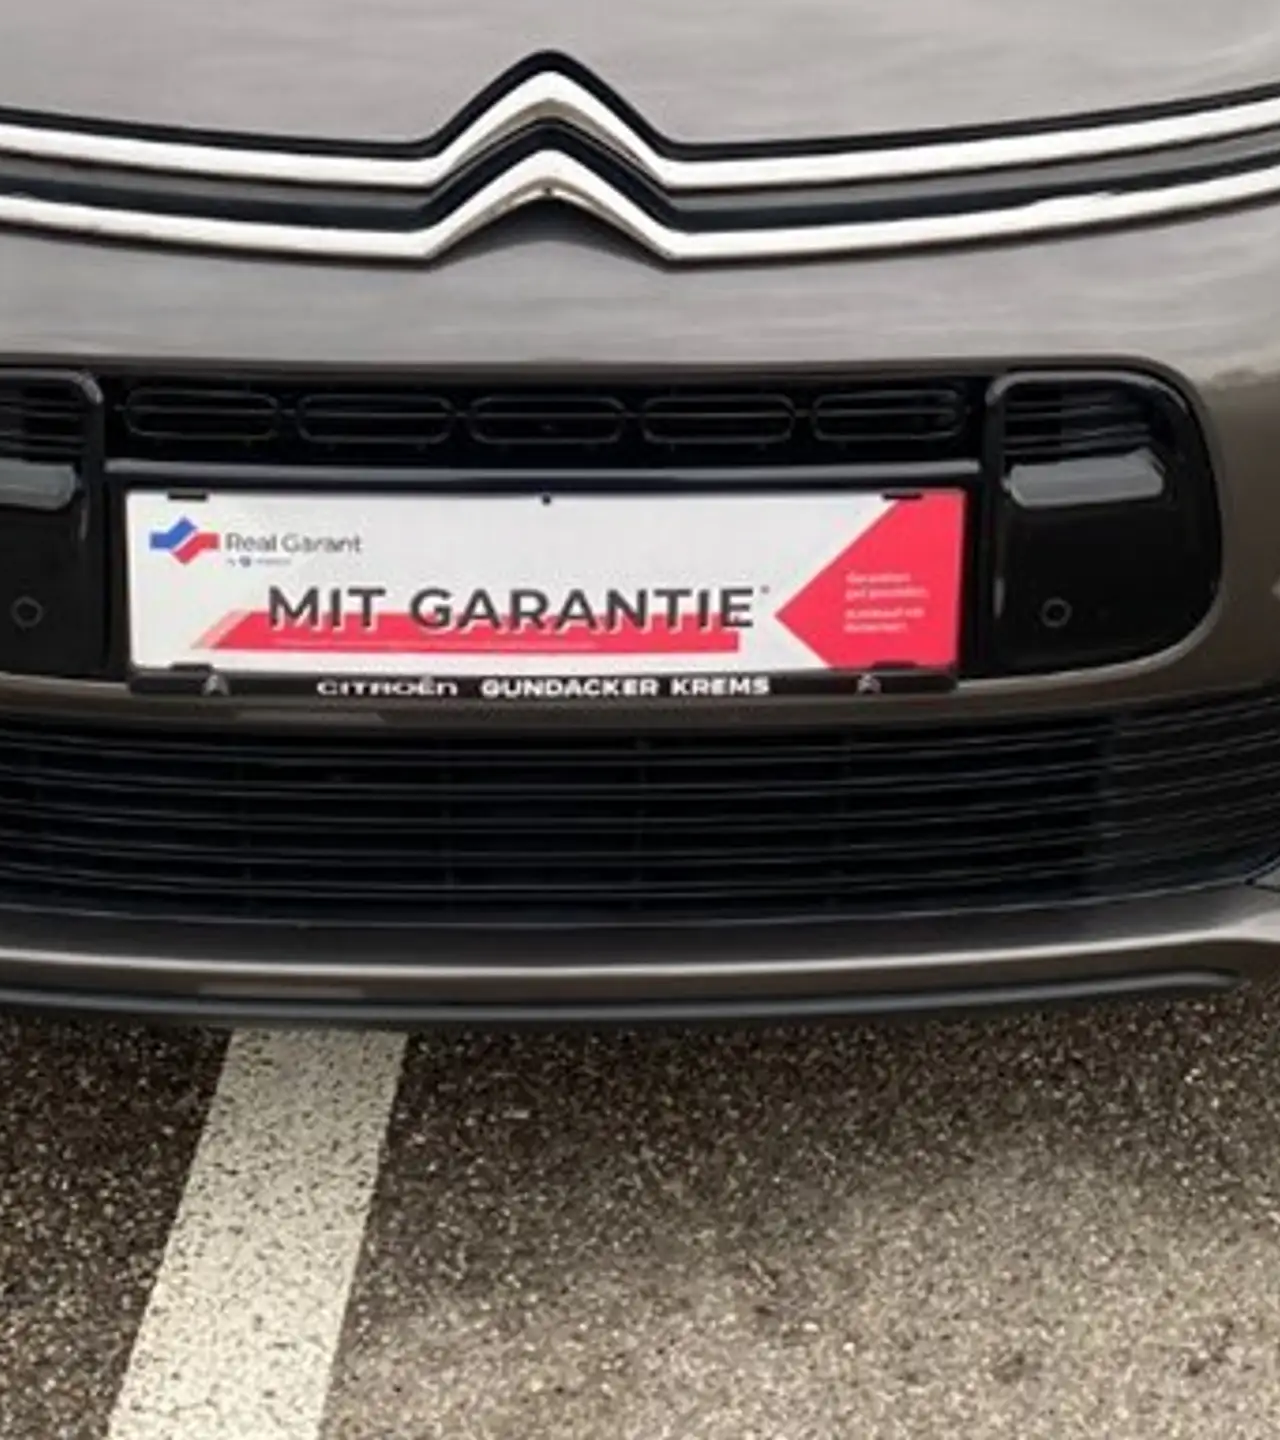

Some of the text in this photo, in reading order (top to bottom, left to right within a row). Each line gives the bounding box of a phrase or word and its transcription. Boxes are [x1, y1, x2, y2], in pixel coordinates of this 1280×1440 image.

[225, 532, 362, 553] Real Garant
[269, 586, 387, 628] MIT
[481, 677, 660, 698] GUNDACKER
[670, 676, 770, 696] KREMS
